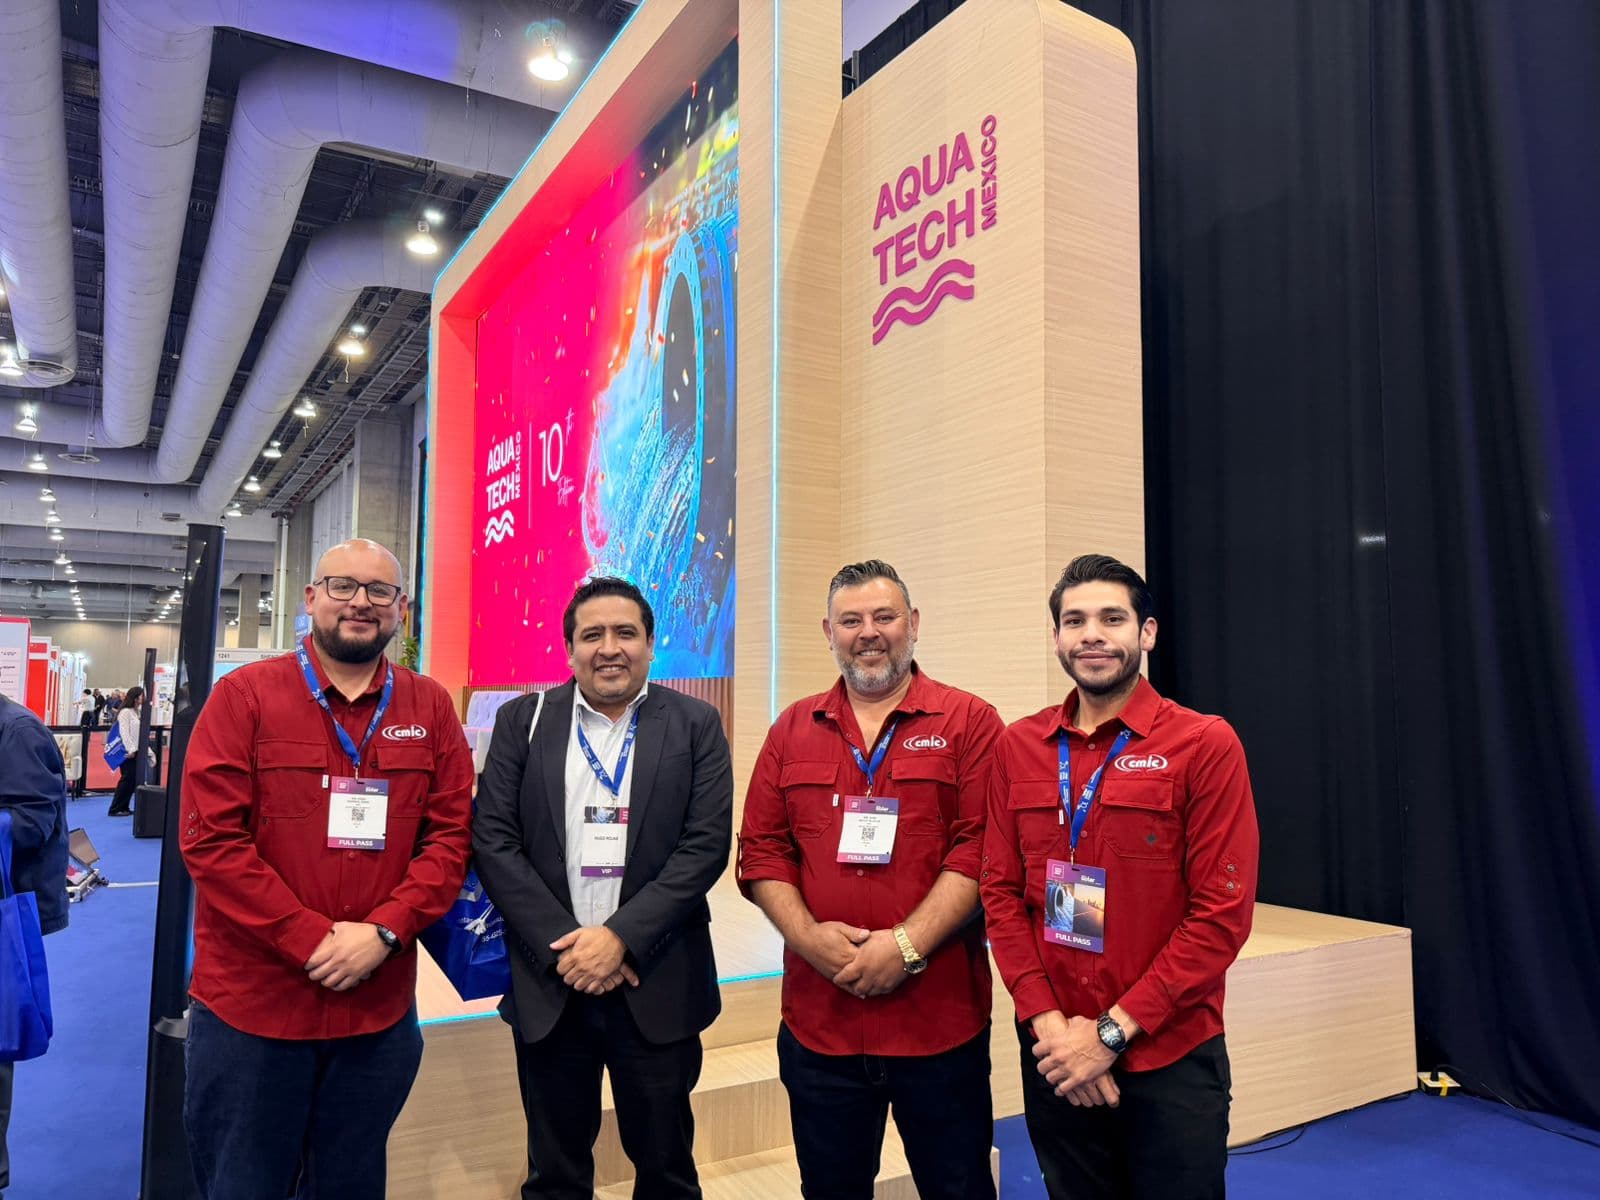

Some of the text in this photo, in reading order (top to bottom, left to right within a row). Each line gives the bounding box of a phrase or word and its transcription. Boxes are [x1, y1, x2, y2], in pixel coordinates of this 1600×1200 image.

[873, 132, 975, 231] AQUA
[981, 114, 997, 231] MEXICO
[873, 188, 975, 286] TECH
[487, 437, 515, 477] AQUA
[538, 422, 563, 487] 10
[486, 471, 515, 512] TECH
[1055, 932, 1092, 946] FULL PASS
